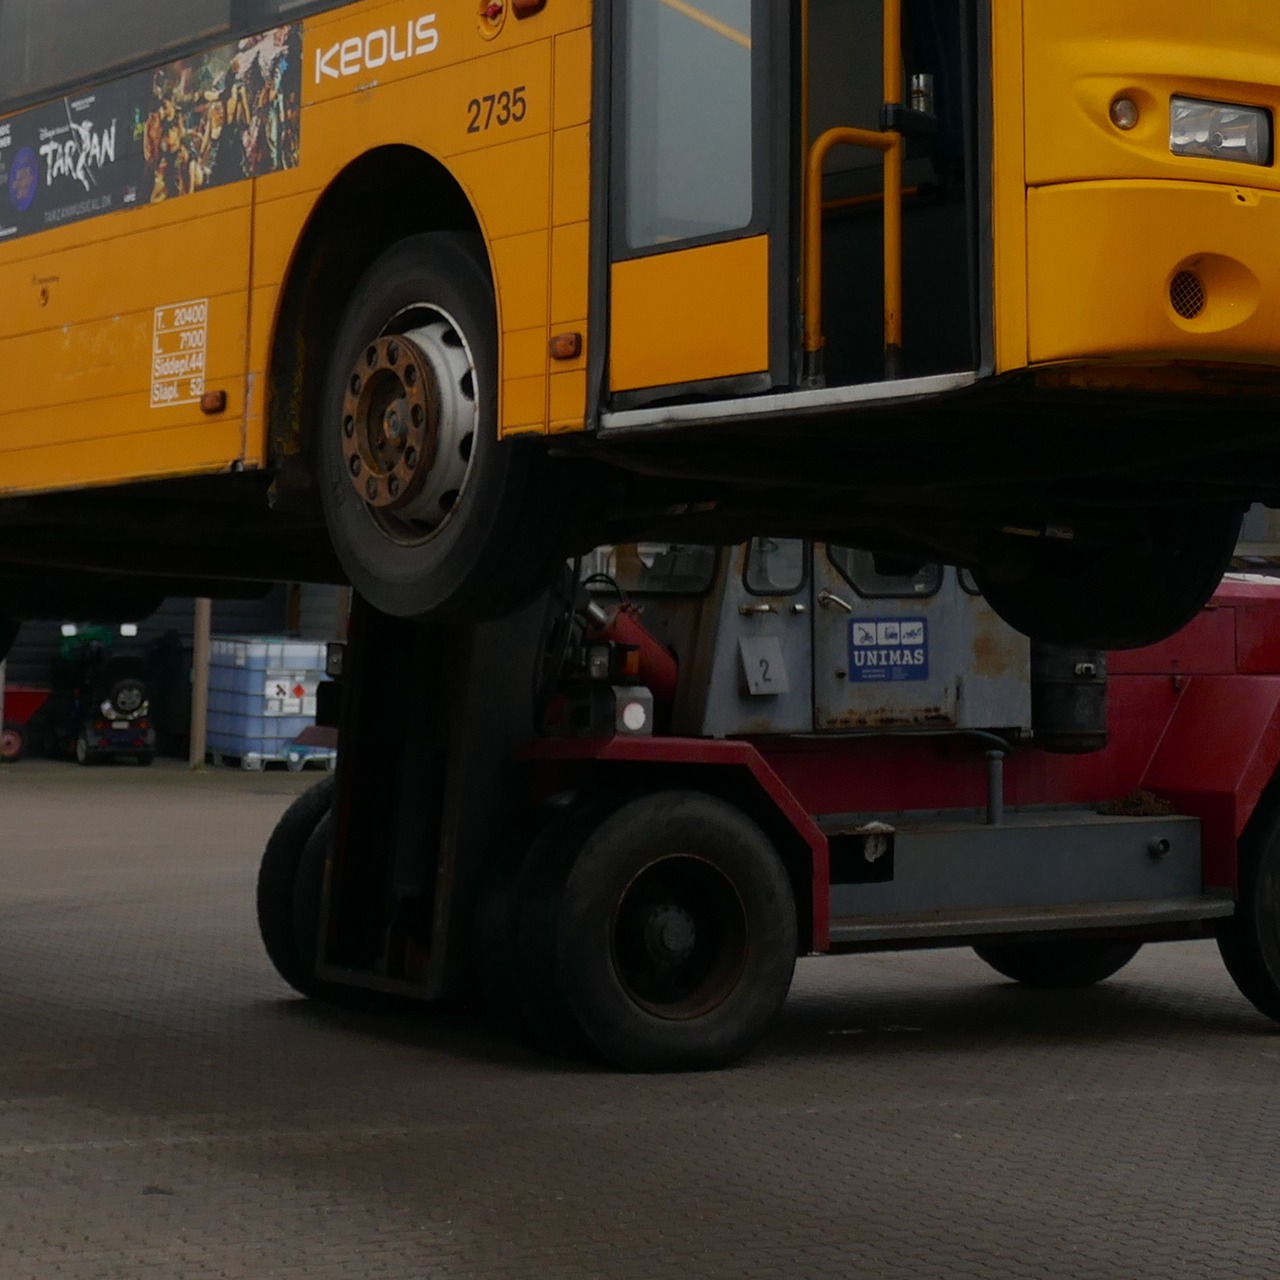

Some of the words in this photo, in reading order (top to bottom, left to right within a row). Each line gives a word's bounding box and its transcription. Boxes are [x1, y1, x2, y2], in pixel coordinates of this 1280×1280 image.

[466, 86, 527, 134] 2735
[39, 118, 117, 192] TARZAN
[174, 304, 205, 327] 20400
[759, 658, 771, 682] 2
[853, 650, 924, 667] UNIMAS
